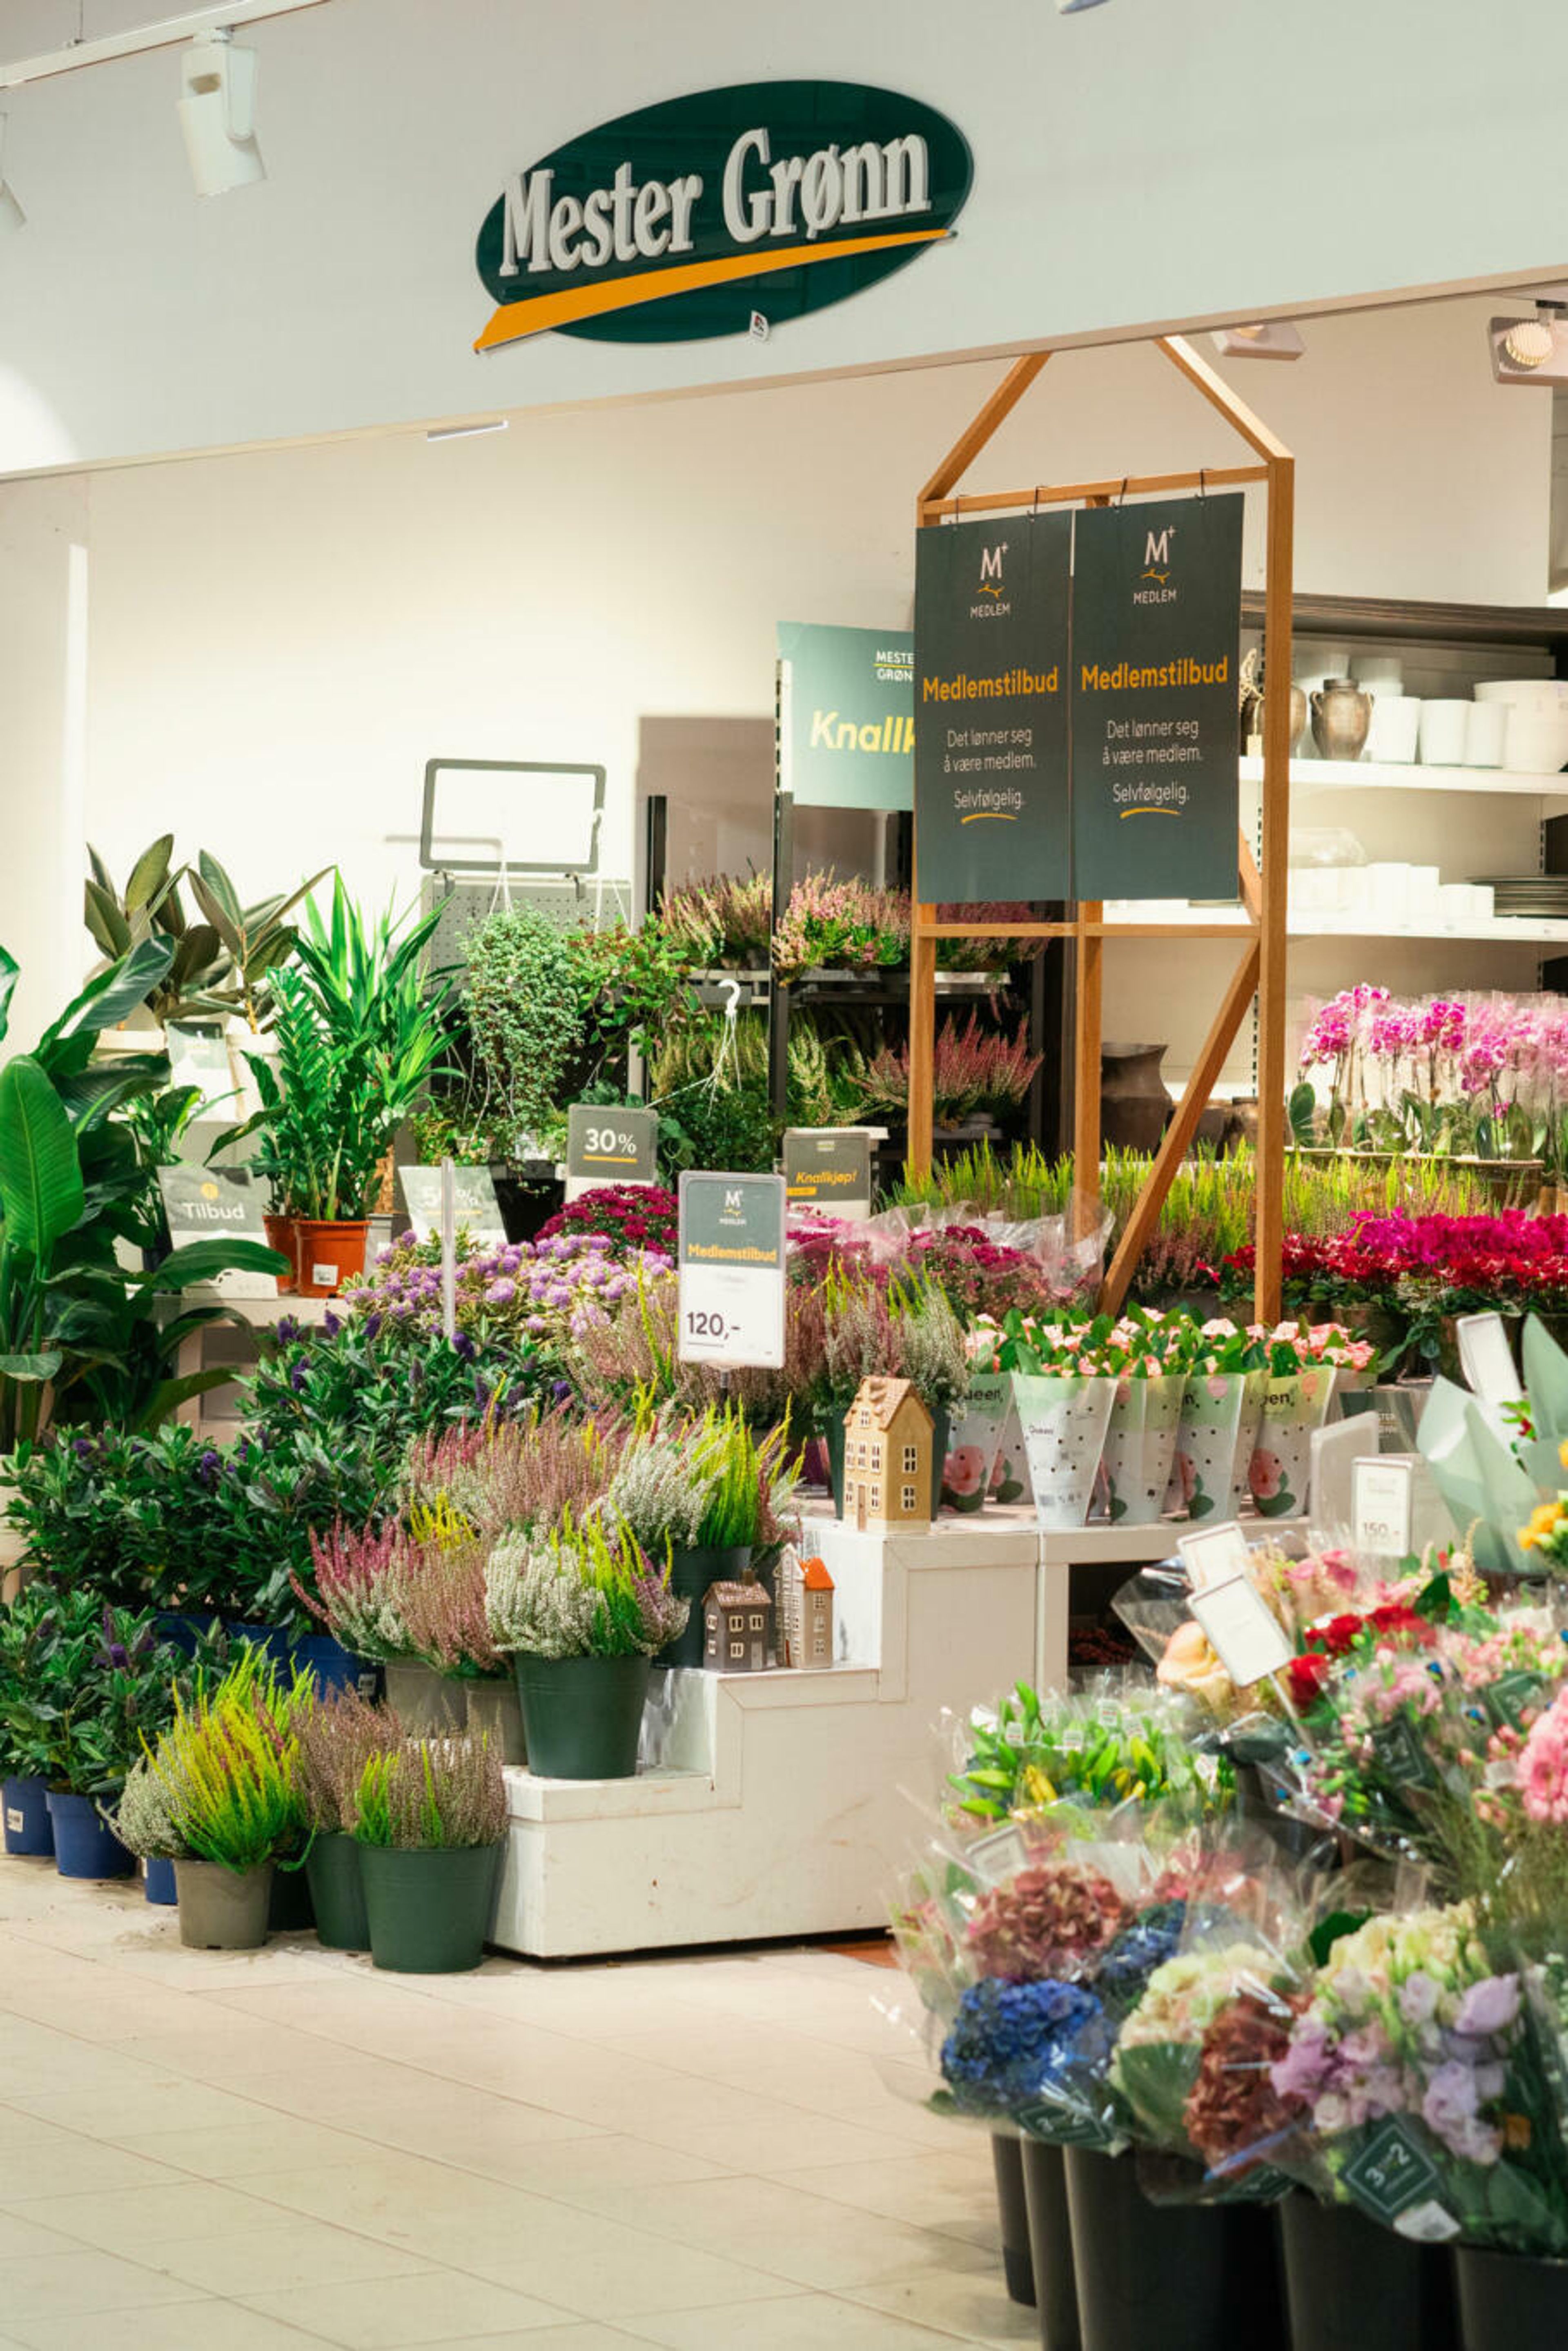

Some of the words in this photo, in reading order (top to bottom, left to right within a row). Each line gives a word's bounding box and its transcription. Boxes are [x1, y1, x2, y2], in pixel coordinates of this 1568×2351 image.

[499, 162, 703, 277] Mester
[723, 127, 931, 243] Grønn
[1134, 587, 1176, 605] MEDLEM
[970, 602, 1011, 619] MEDLEM
[923, 665, 1059, 703] Medlemstilbud
[1081, 654, 1228, 691] Medlemstilbud
[947, 729, 968, 747] Det
[971, 729, 1009, 746] lønner
[1011, 728, 1033, 747] seg
[1107, 720, 1129, 739] Det
[1131, 718, 1175, 737] lønner
[1176, 720, 1199, 740] seg
[944, 753, 951, 773] å
[953, 757, 982, 772] være
[1102, 746, 1110, 765] å
[1112, 748, 1144, 765] være
[1146, 743, 1203, 764] medlem.
[953, 787, 1027, 811] Selvfølgelig.
[1112, 780, 1190, 806] Selvfølgelig.
[585, 1128, 637, 1155] 30%
[182, 1202, 245, 1220] Tilbud
[687, 1312, 741, 1341] 120,-
